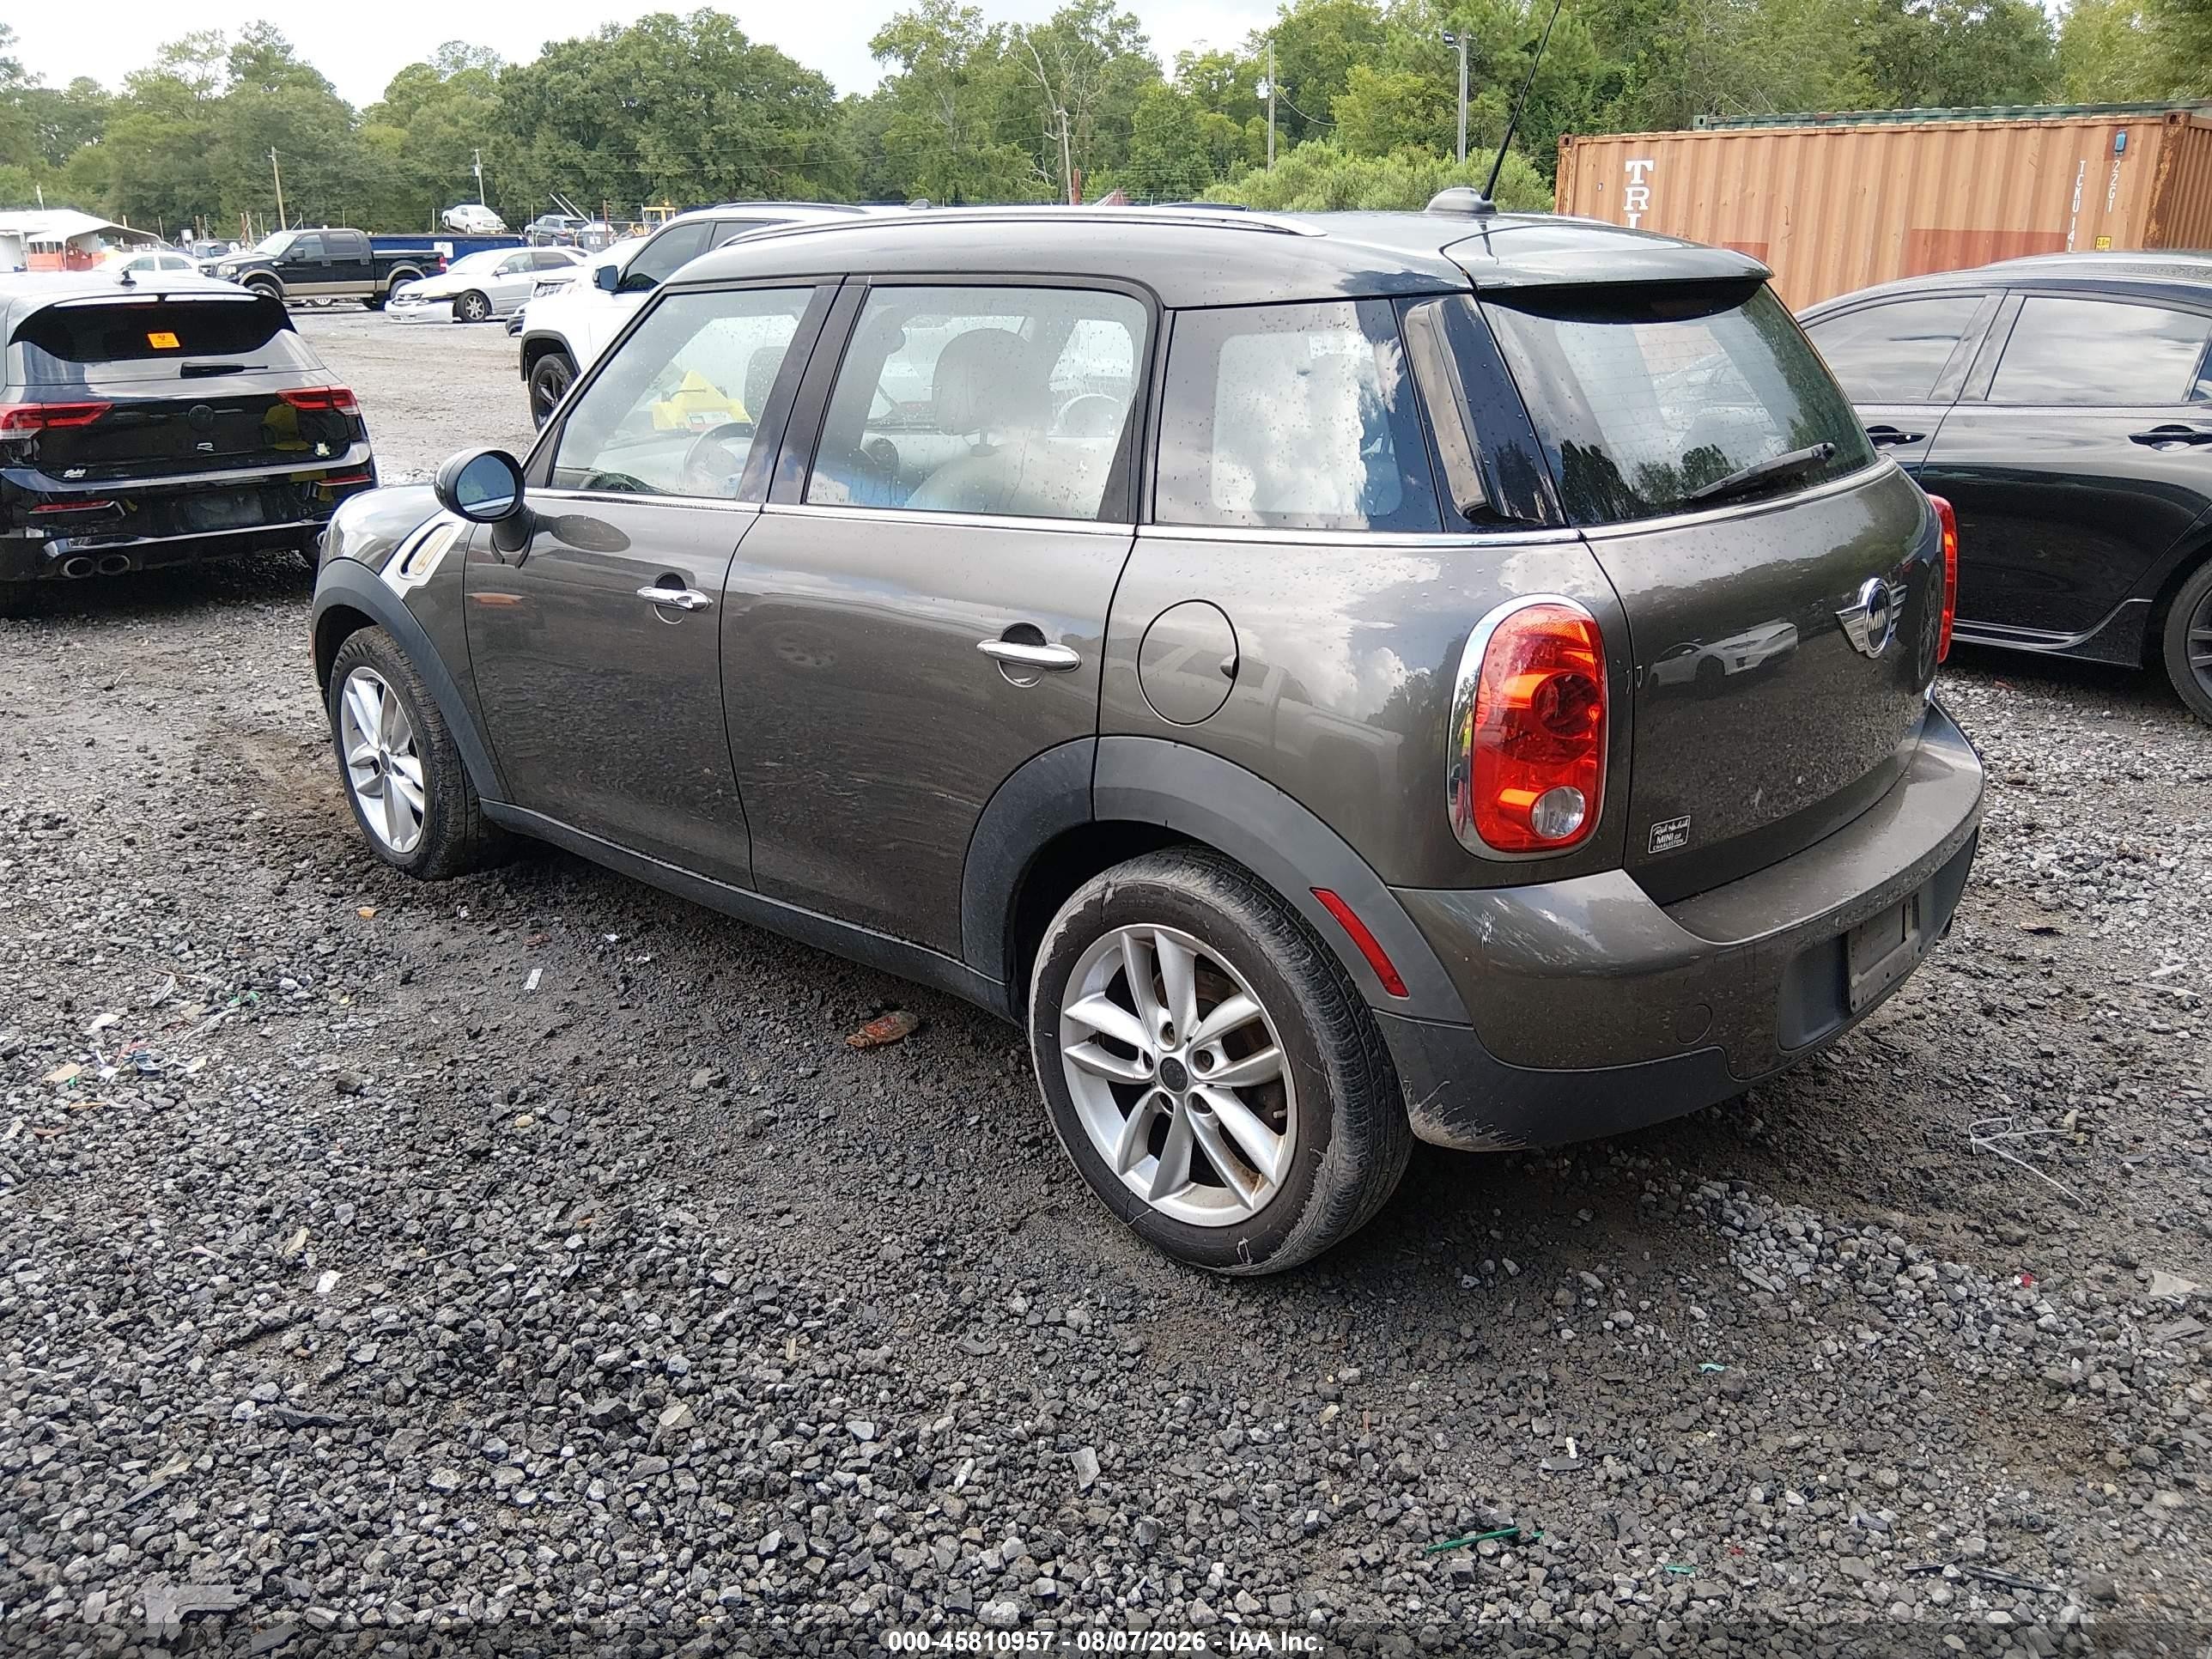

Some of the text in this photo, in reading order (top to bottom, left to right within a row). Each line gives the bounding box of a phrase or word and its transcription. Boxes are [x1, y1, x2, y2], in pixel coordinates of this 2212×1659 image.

[2072, 160, 2087, 214] TCKU
[2106, 160, 2122, 213] 22G1
[1868, 608, 1887, 633] MIN
[1656, 832, 1674, 845] MINI
